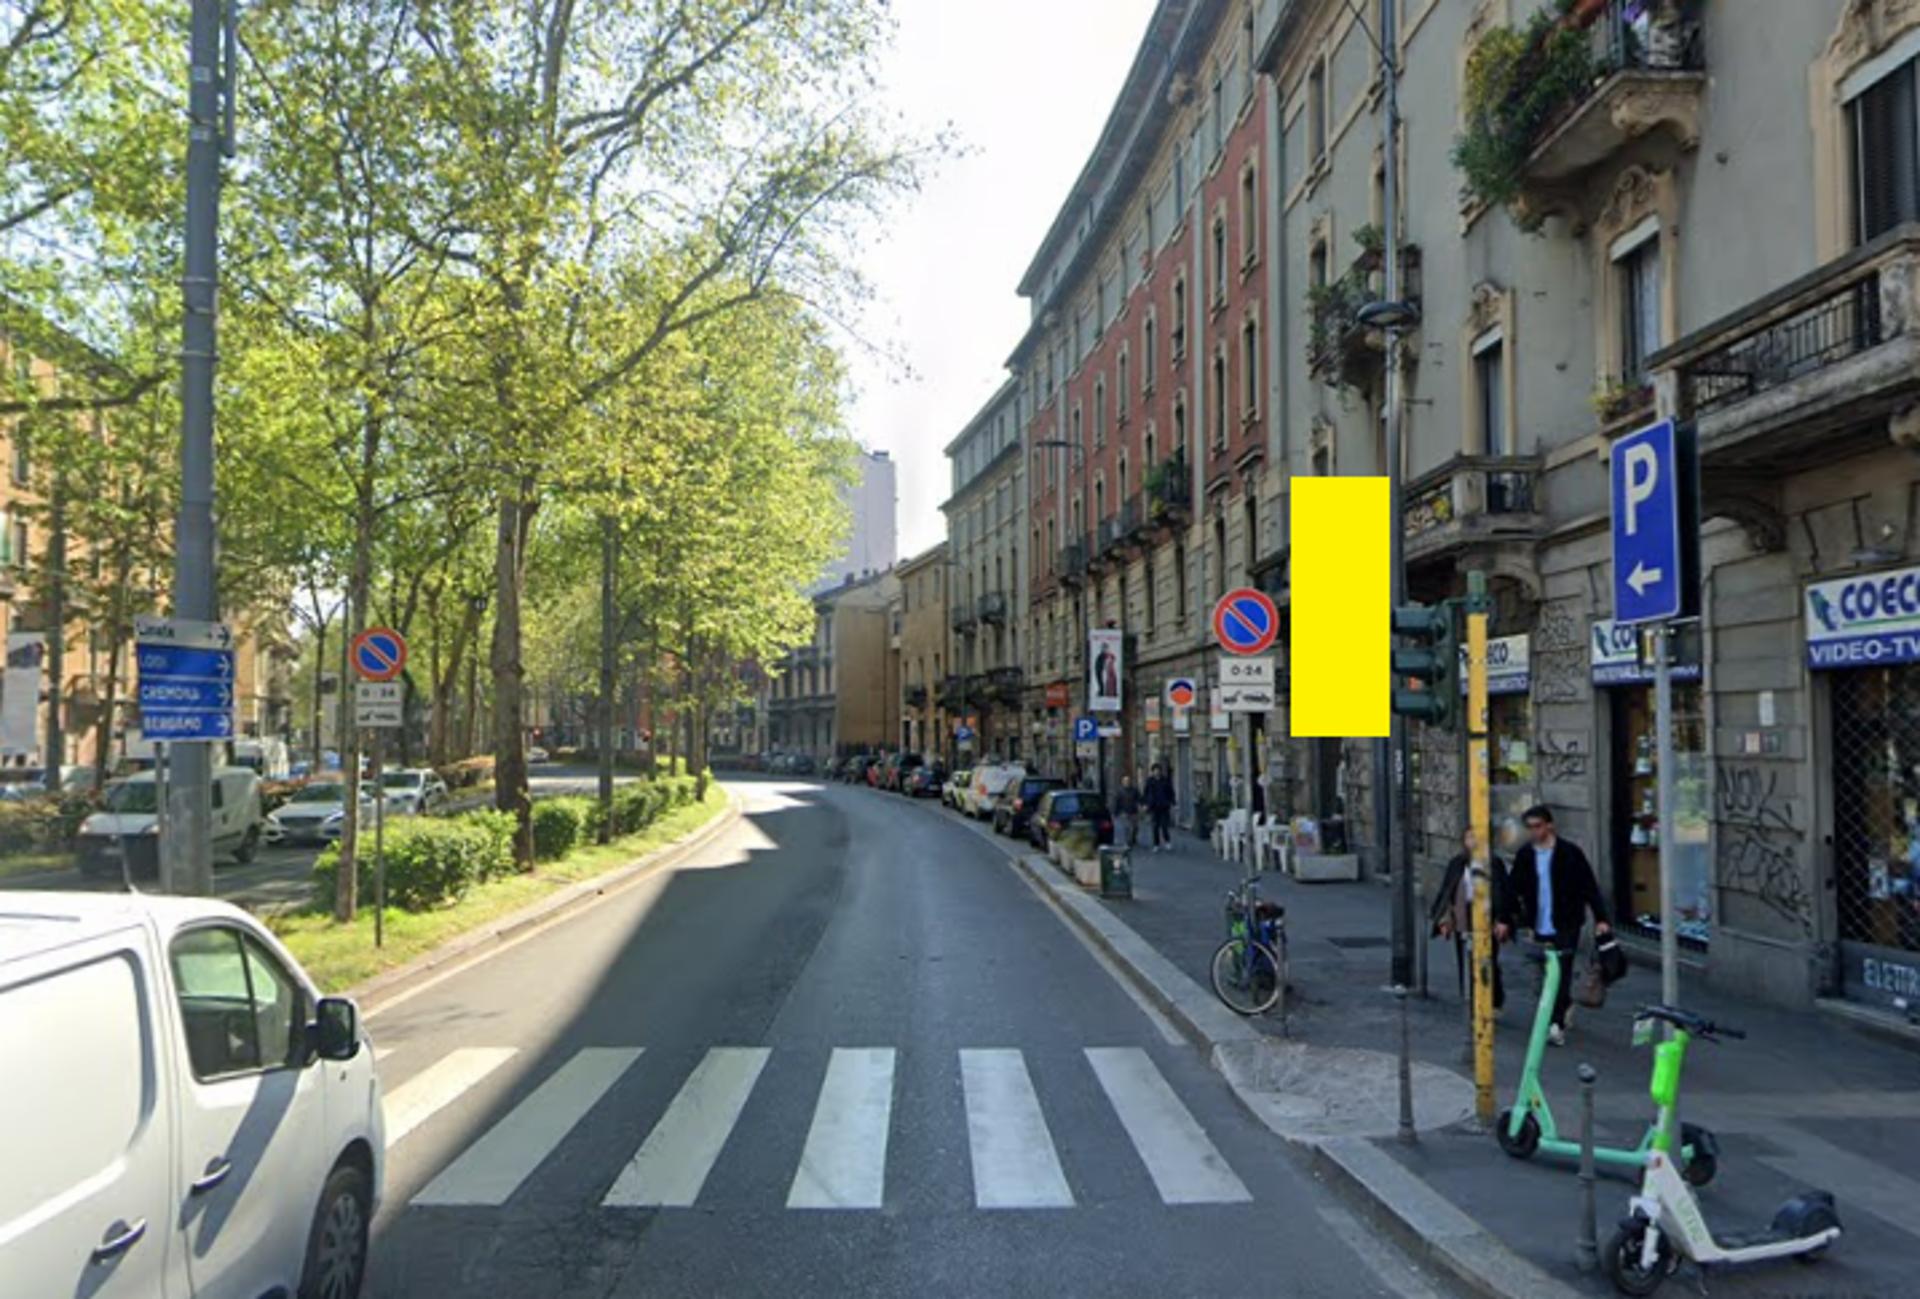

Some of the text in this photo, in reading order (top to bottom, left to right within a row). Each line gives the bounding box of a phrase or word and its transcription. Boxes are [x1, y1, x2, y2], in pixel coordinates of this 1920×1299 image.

[1625, 442, 1658, 535] P
[1841, 574, 1920, 621] COEC
[1079, 720, 1093, 738] P
